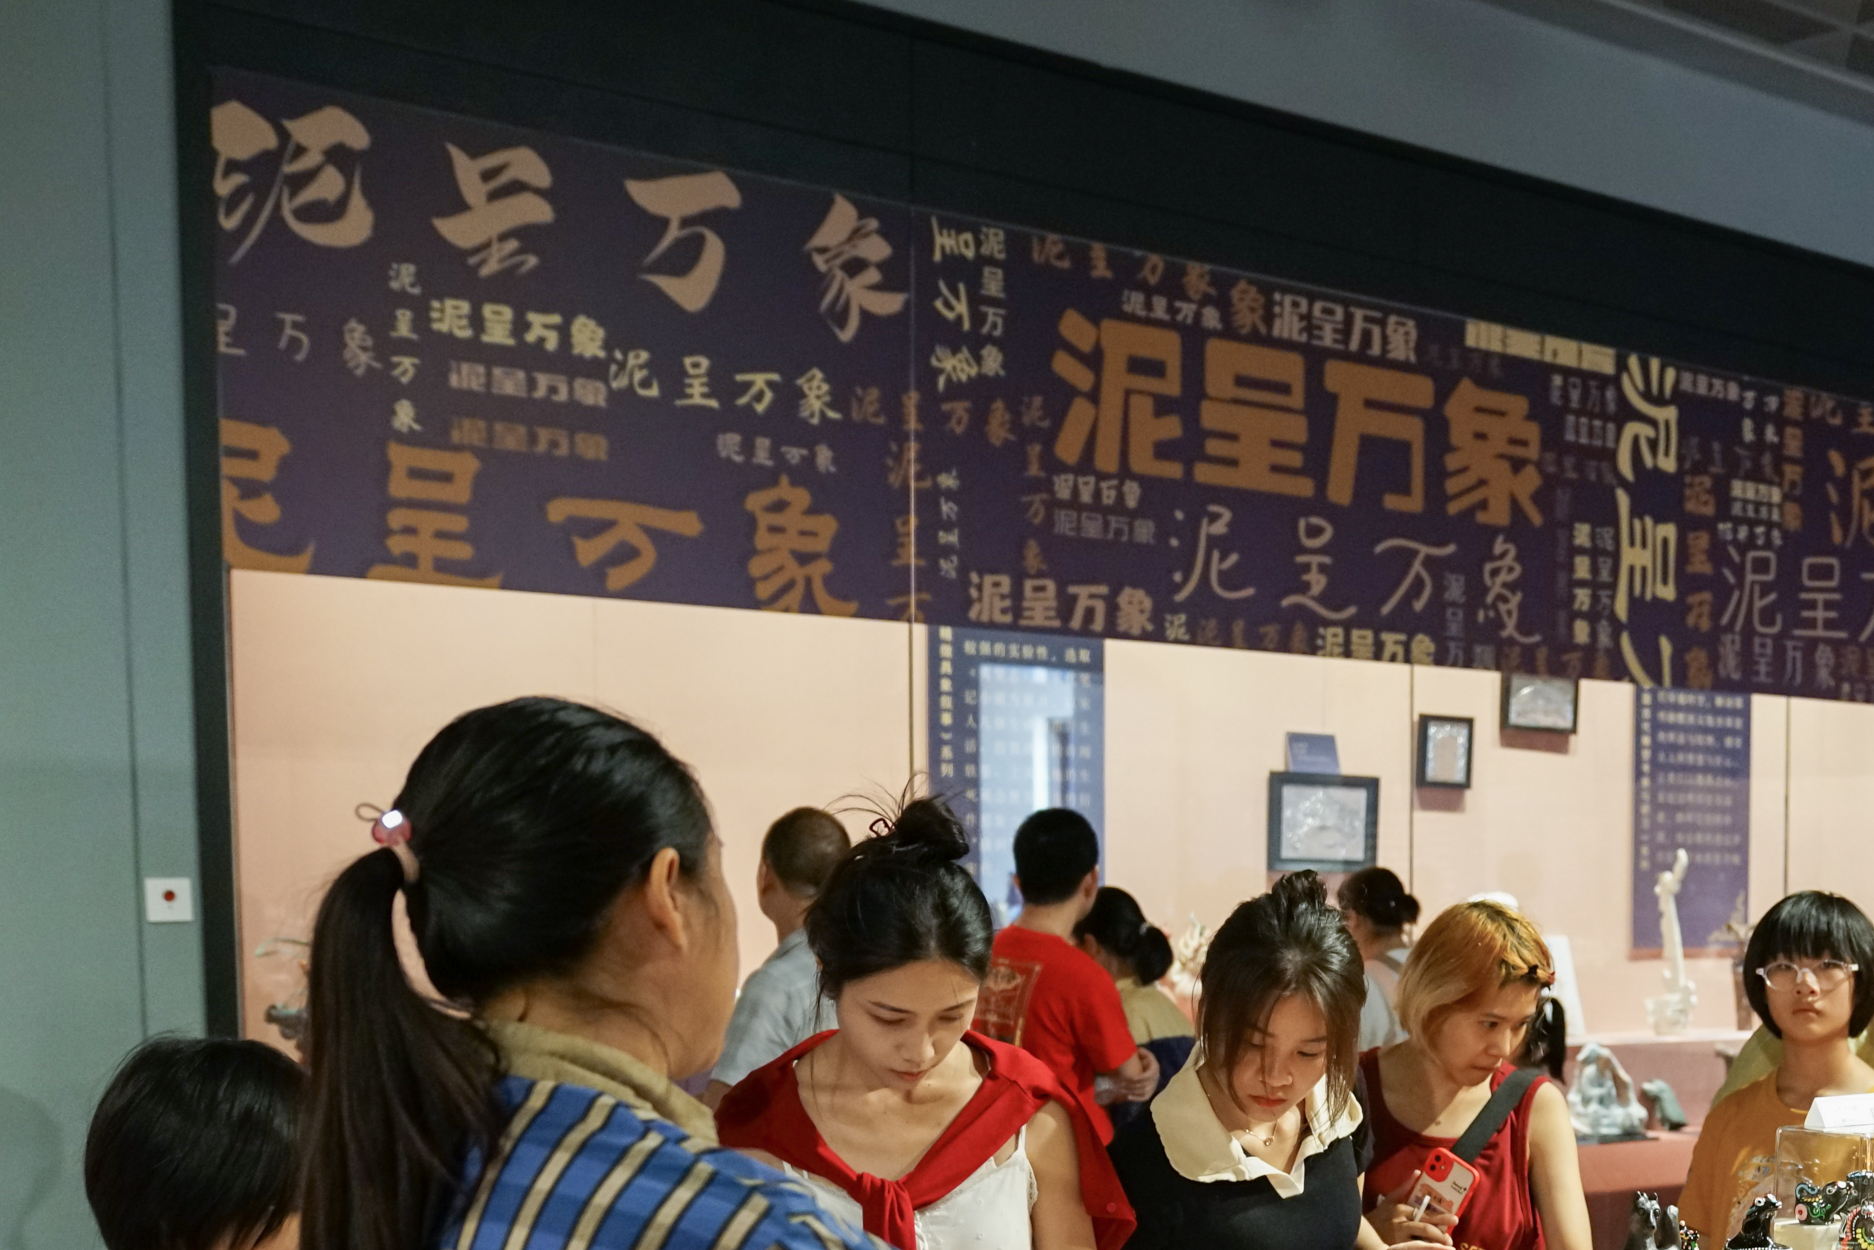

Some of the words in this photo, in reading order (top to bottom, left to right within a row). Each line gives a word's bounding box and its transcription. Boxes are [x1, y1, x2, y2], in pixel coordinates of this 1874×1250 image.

[210, 100, 908, 343] 泥呈万象
[430, 299, 606, 358] 泥呈万象
[979, 226, 1006, 377] 泥呈万象
[1272, 293, 1418, 363] 泥呈万象
[388, 262, 422, 432] 泥呈万象
[608, 348, 842, 424] 泥呈万象
[1052, 307, 1545, 528] 泥呈万象
[968, 571, 1155, 634] 泥呈万象
[1169, 505, 1541, 643] 泥呈万象
[1316, 626, 1436, 667] 泥呈万象
[1717, 633, 1836, 690] 泥呈万象
